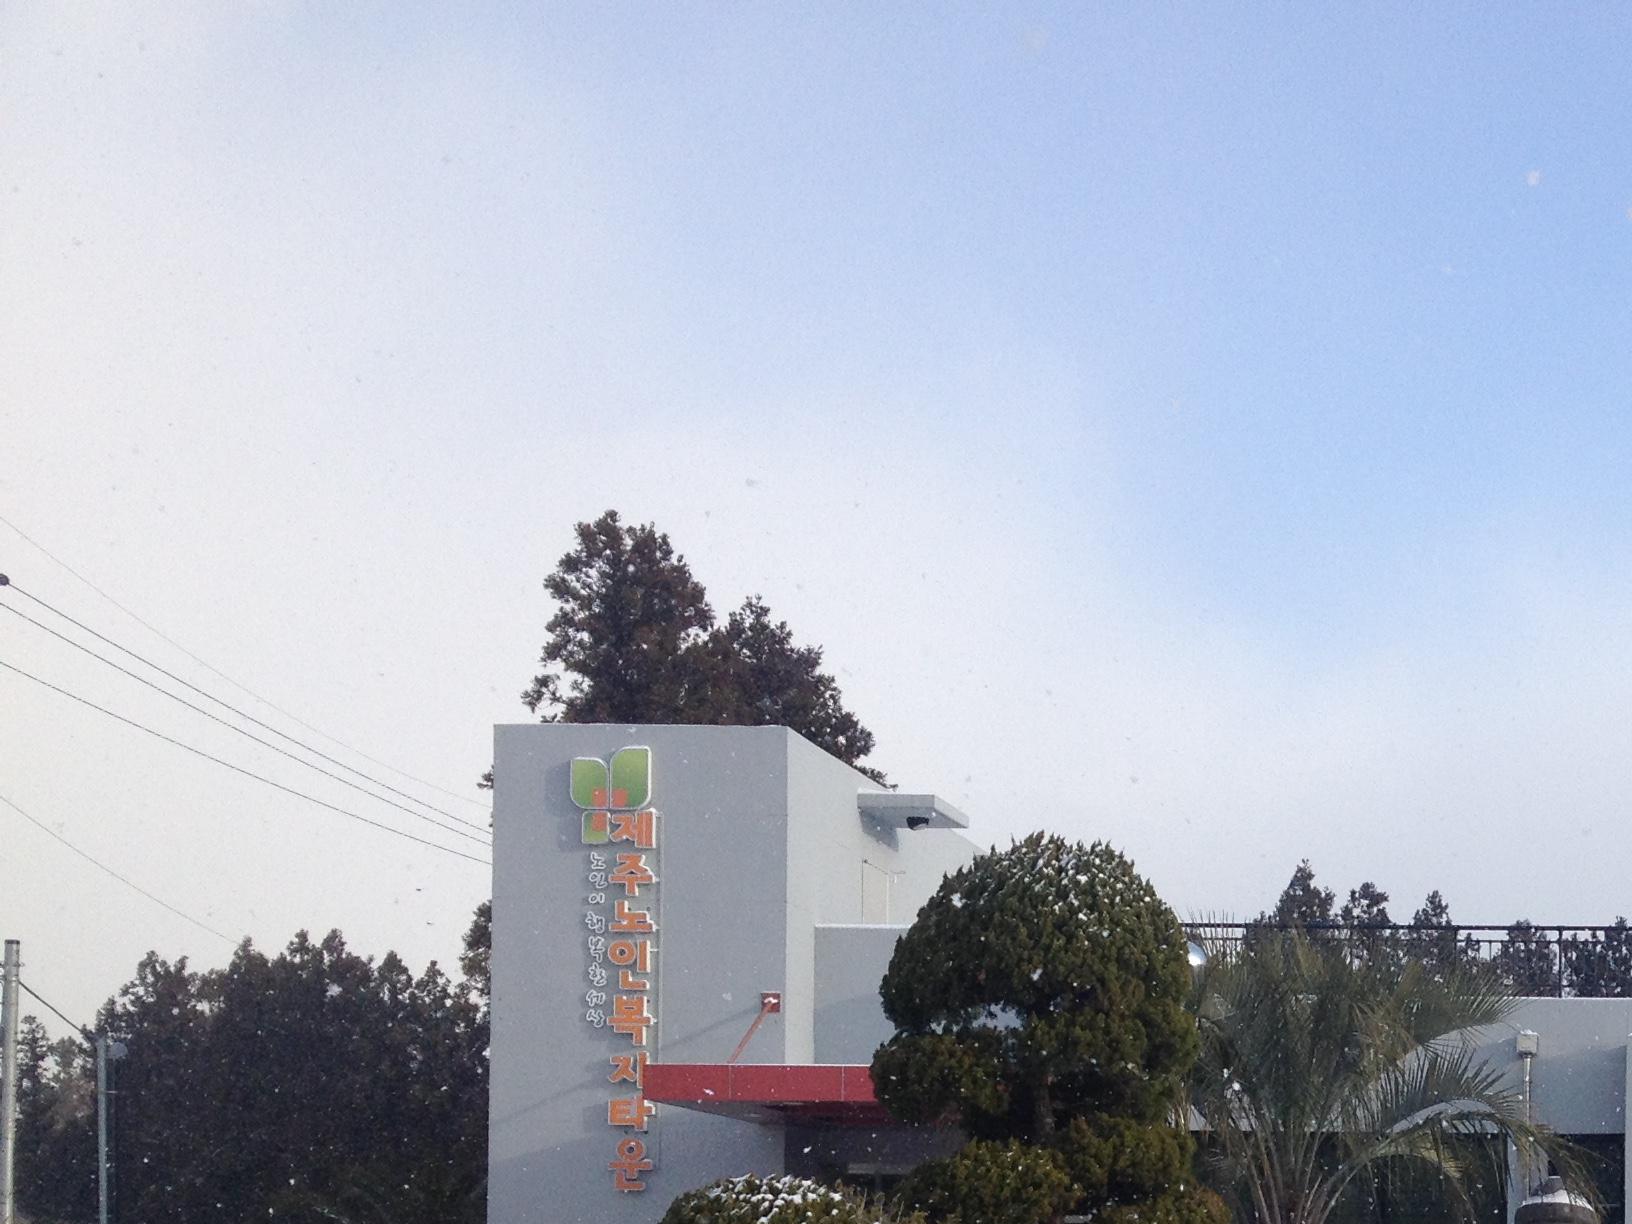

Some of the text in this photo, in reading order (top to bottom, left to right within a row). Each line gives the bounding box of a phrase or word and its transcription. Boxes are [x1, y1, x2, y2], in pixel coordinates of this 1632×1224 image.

[585, 852, 607, 1027] 노인이 행복한 세상
[606, 808, 656, 1190] 제주노인복지타운
